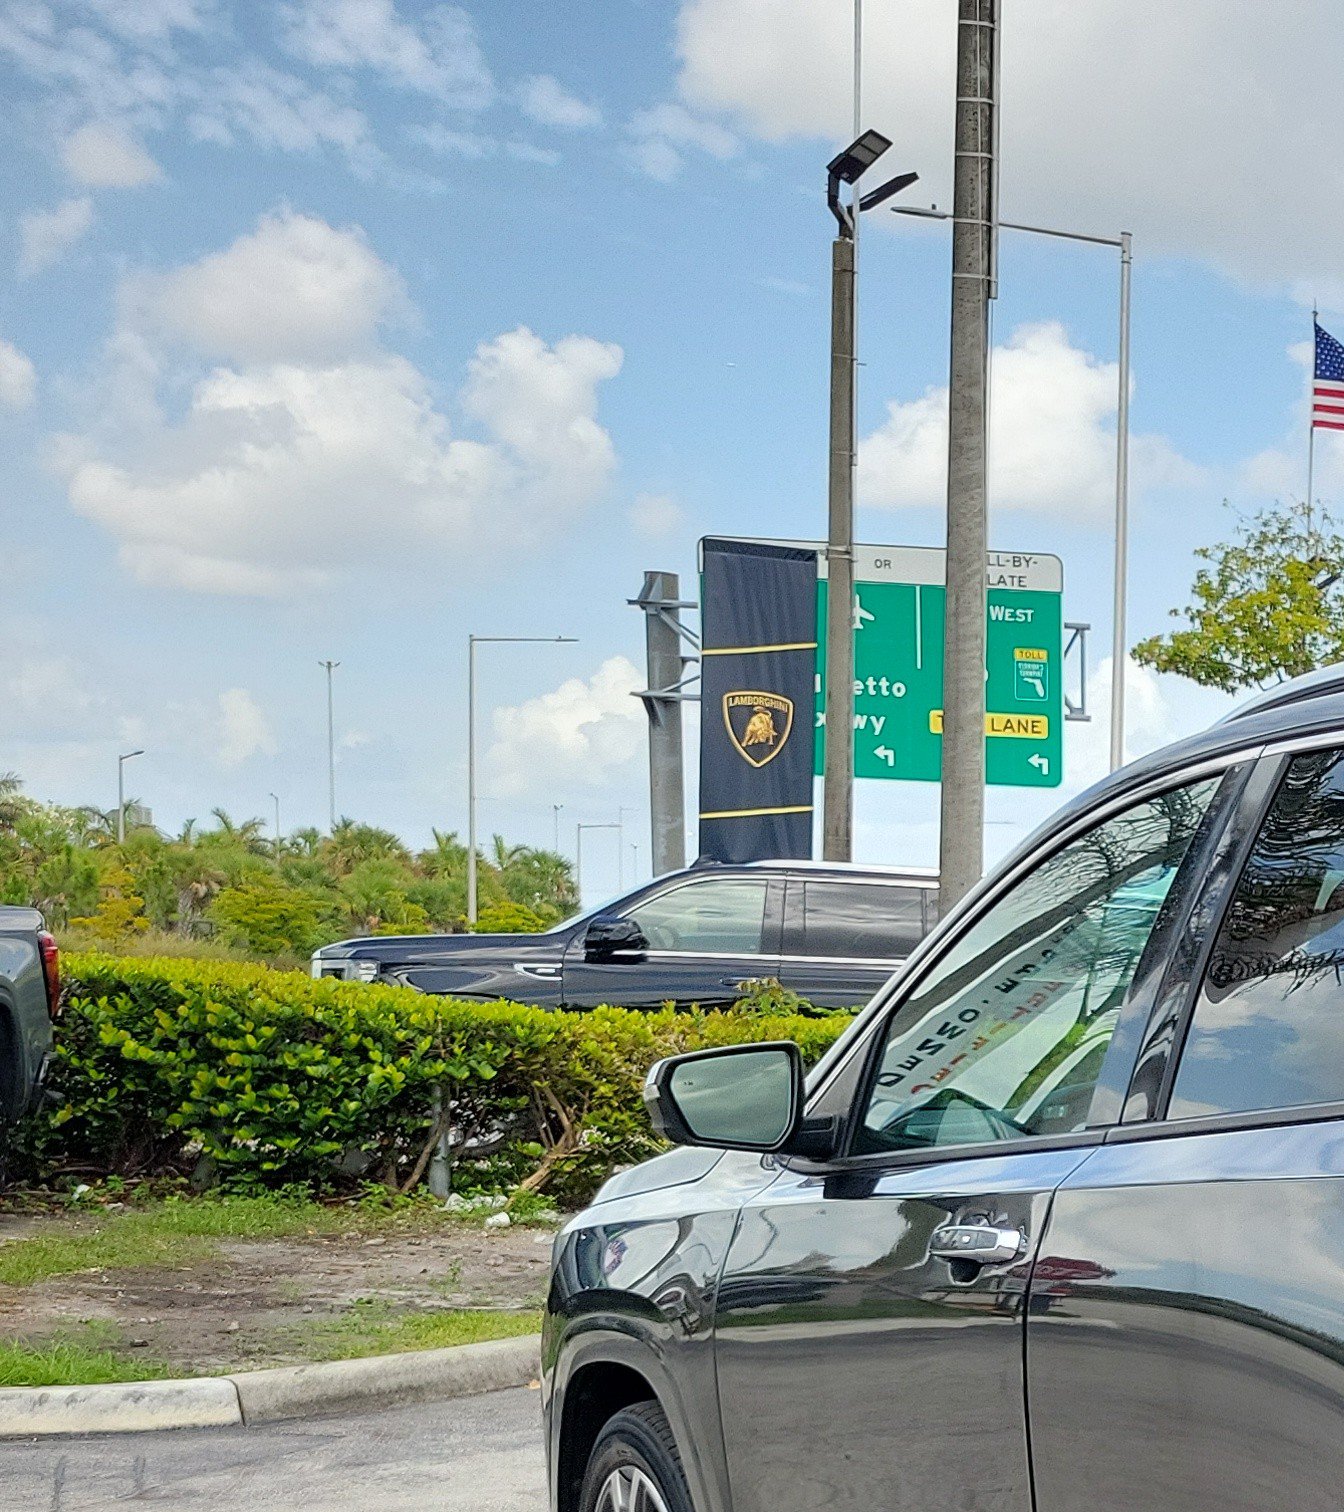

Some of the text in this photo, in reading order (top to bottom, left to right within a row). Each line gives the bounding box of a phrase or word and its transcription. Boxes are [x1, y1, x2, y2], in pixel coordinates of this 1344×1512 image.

[874, 558, 892, 570] OR
[987, 554, 1038, 568] LL-BY-
[987, 573, 1028, 588] LATE
[988, 604, 1035, 624] WEST
[1018, 650, 1045, 660] TOLL
[814, 673, 907, 699] letto
[728, 695, 789, 713] LAMBORGHINI
[990, 717, 1043, 735] LANE
